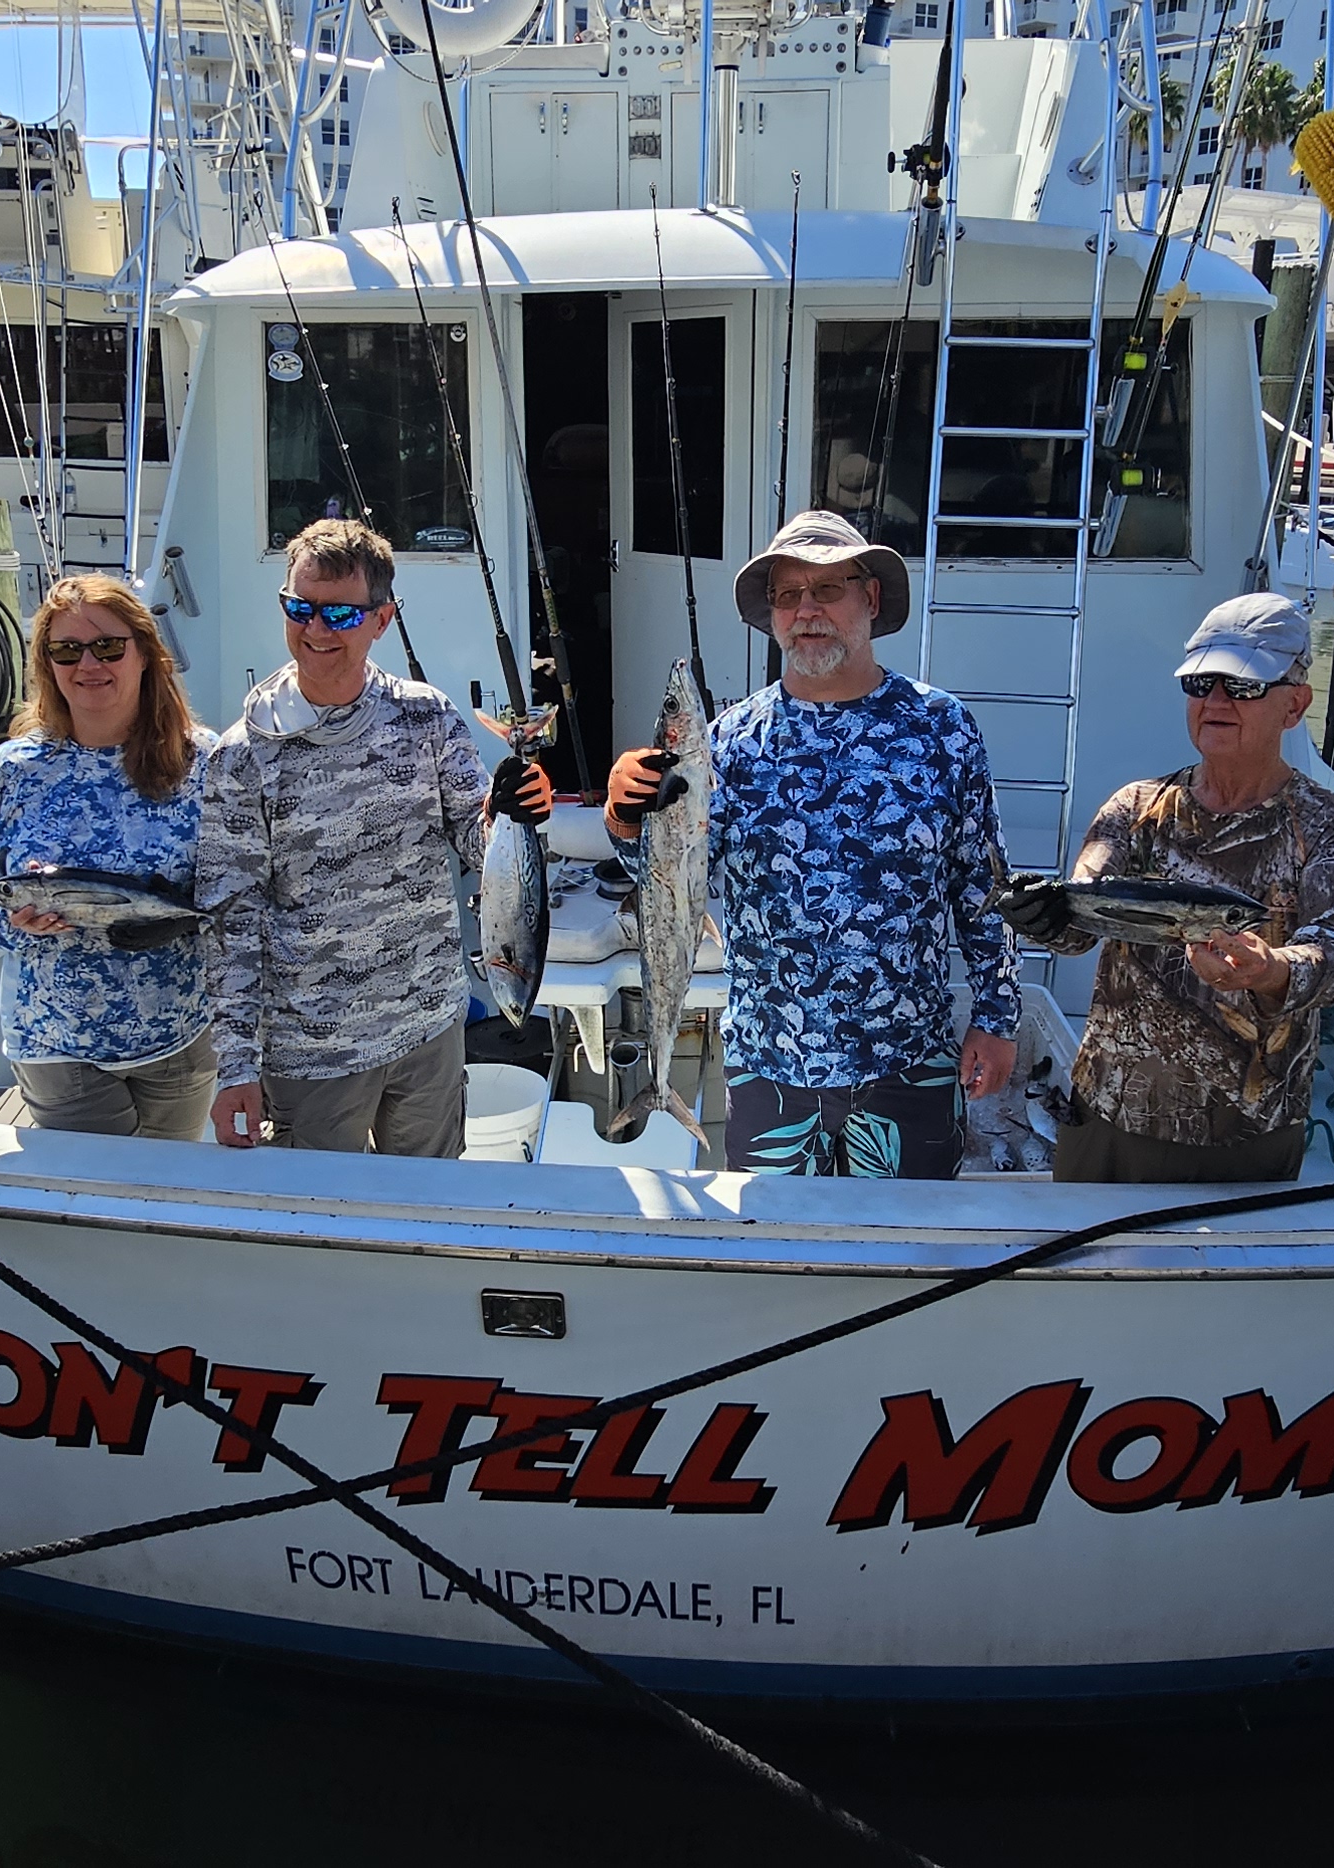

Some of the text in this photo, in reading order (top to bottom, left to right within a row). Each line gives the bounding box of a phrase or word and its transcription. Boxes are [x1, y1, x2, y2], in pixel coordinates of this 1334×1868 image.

[375, 1372, 778, 1515] TELL
[285, 1545, 796, 1628] FORT LAUDERDALE, FL
